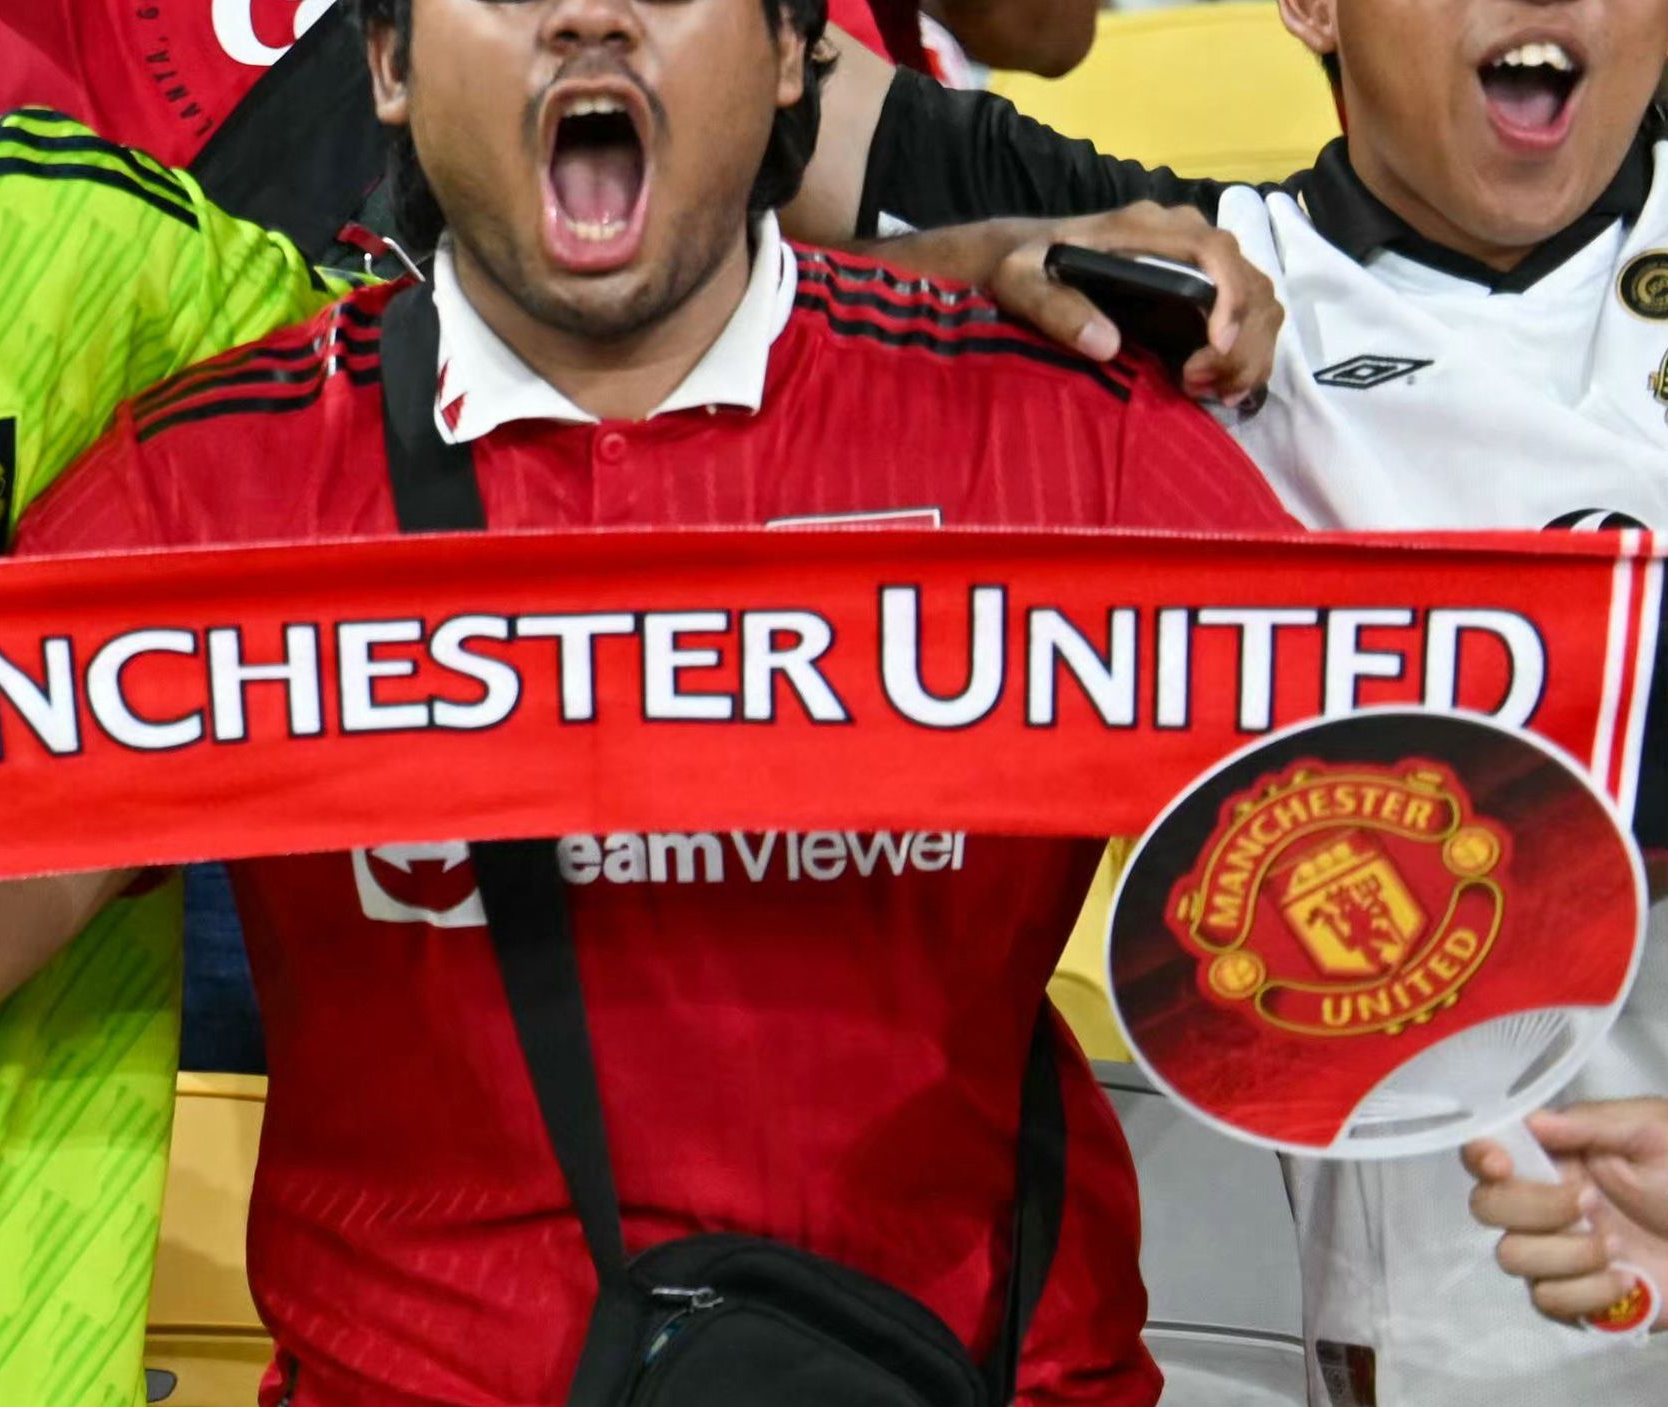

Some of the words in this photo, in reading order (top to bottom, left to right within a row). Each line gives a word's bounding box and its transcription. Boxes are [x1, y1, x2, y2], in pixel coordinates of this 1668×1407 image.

[145, 37, 214, 138] LANTA,
[879, 584, 1548, 732] UNITED
[558, 831, 966, 884] eamViewer
[1208, 786, 1433, 929] MANCHESTER
[1321, 928, 1479, 1027] UNITED
